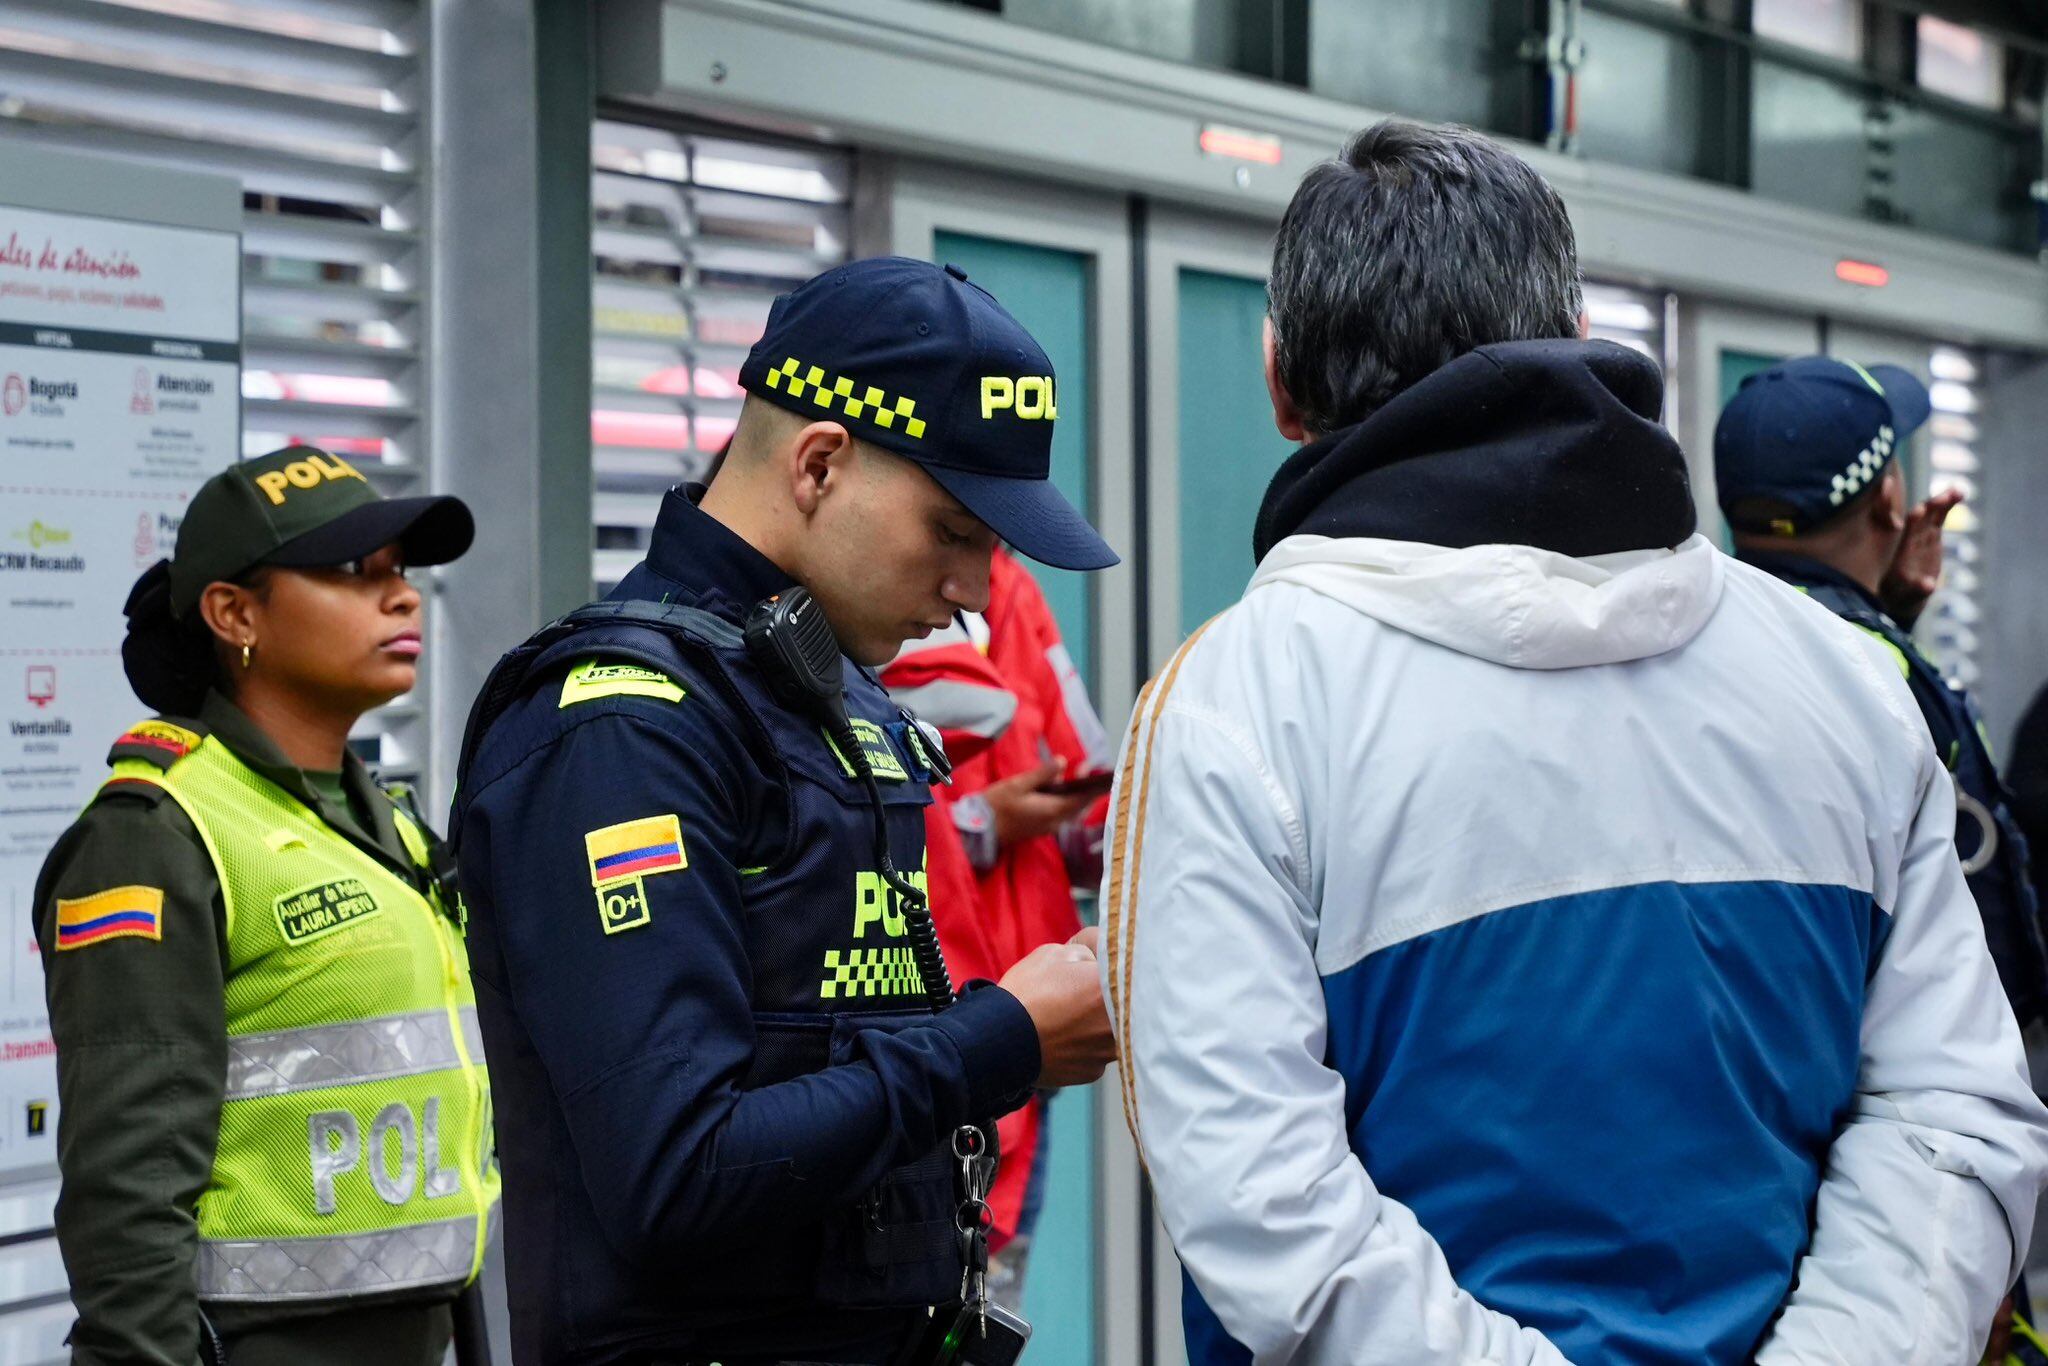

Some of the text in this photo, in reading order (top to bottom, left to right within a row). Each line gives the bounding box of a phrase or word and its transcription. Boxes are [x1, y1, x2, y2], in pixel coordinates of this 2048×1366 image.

[38, 239, 57, 270] de
[30, 376, 77, 400] Bogotá
[158, 373, 214, 394] Atención
[980, 376, 1056, 420] POL
[31, 556, 85, 573] Recaudo
[10, 718, 72, 736] Ventanilla
[290, 906, 337, 936] LAURA
[307, 1096, 461, 1215] POL
